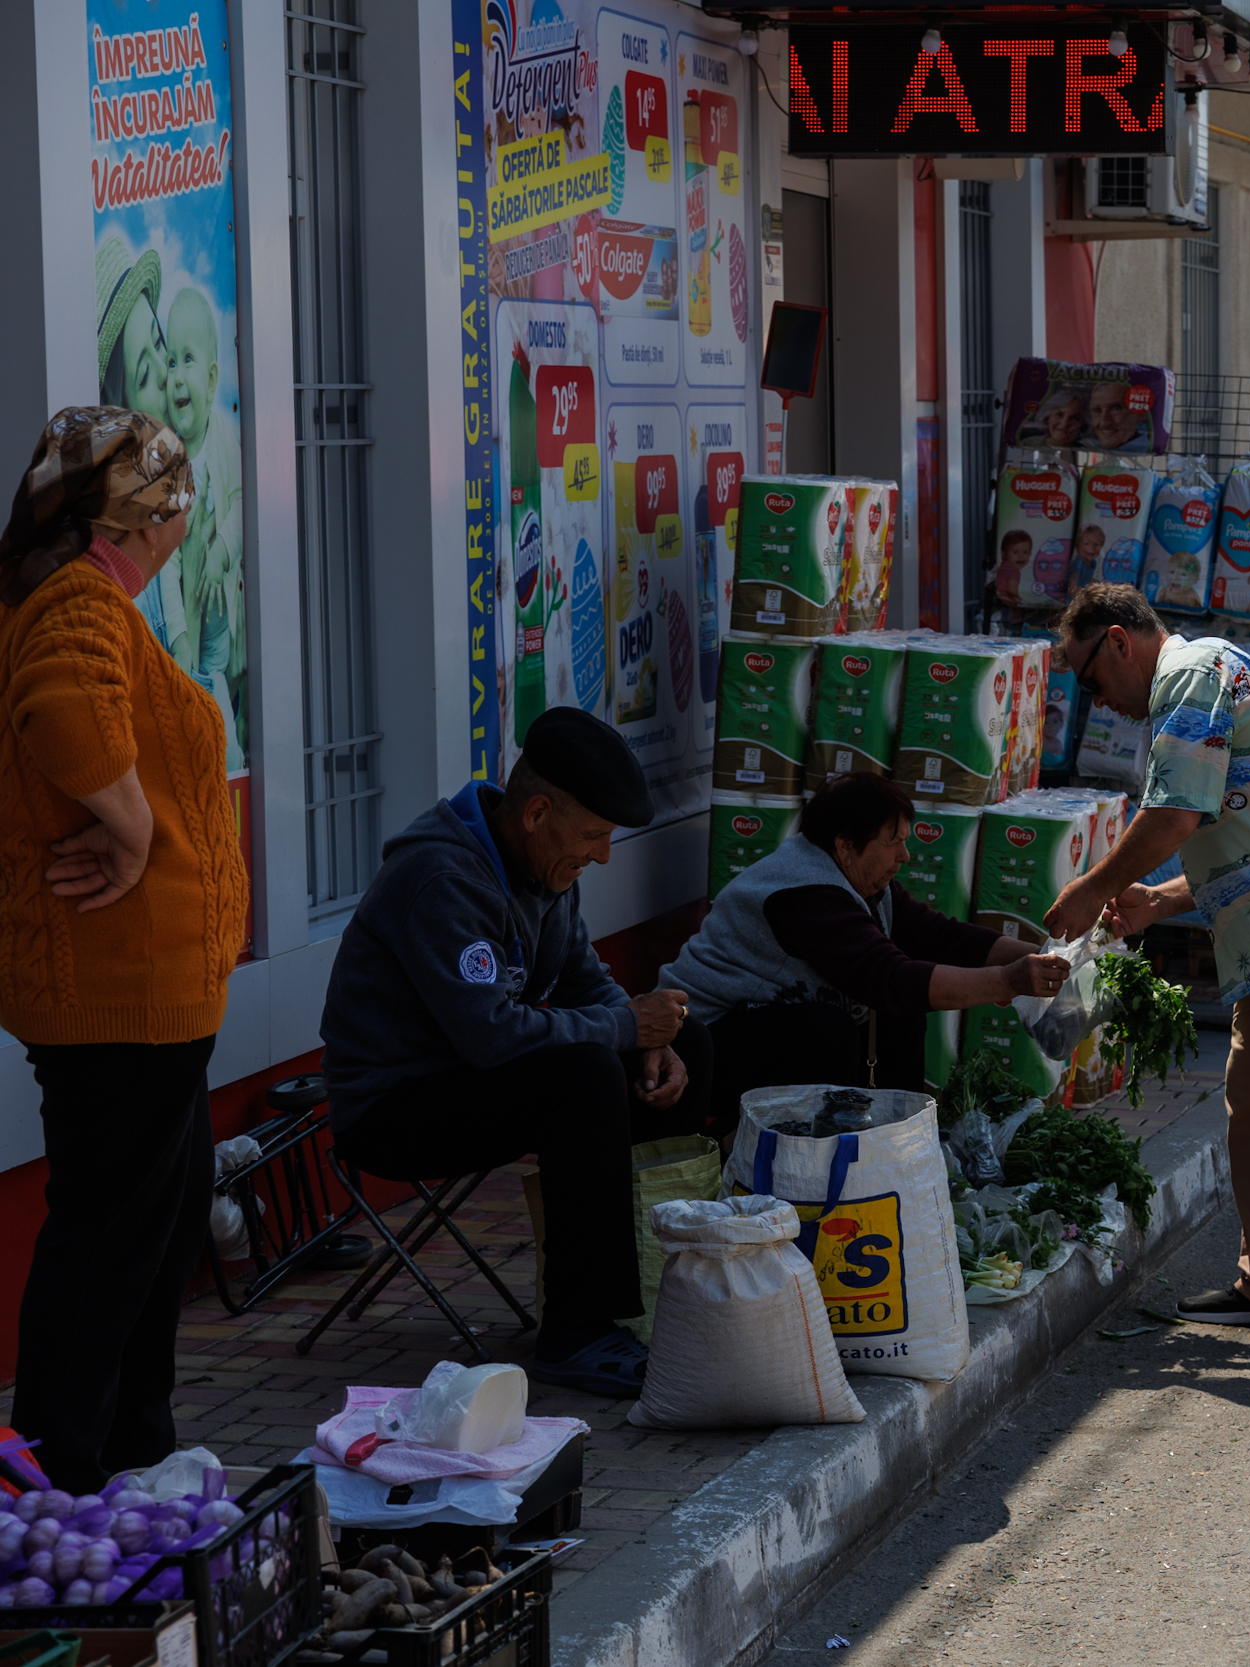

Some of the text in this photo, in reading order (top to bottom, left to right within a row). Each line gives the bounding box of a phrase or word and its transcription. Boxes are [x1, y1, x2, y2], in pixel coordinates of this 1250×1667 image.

[621, 32, 648, 64] COLGATE
[692, 53, 729, 86] MAXI POWER
[491, 28, 598, 139] Detergent Plus
[890, 39, 1164, 132] ATR
[91, 131, 229, 210] Vatalitatea!
[502, 137, 560, 183] OFERTĂ DE
[491, 166, 609, 231] SĂRBĂTORILE PASCALE
[601, 219, 637, 231] Colgate
[505, 242, 535, 281] REDUCERI
[572, 230, 599, 286] -50%
[601, 241, 644, 281] Colgate
[528, 320, 566, 349] DOMESTOS
[1052, 364, 1129, 382] Actual
[454, 41, 488, 781] LIVRARE GRATUITA!
[637, 424, 654, 450] DERO
[704, 423, 732, 447] COCOLINO
[1015, 480, 1057, 491] HUGGIES
[1092, 481, 1134, 493] HUGGIES
[768, 498, 791, 508] Ruta
[1164, 518, 1202, 535] Pampers
[486, 551, 492, 575] LA
[1035, 584, 1042, 592] 5
[525, 637, 542, 651] POWER
[619, 610, 653, 671] DERO
[748, 658, 771, 667] Ruta
[845, 661, 868, 670] Ruta
[932, 668, 955, 678] Ruta
[736, 820, 758, 830] Ruta
[917, 826, 939, 837] Ruta
[1009, 830, 1032, 841] Ruta
